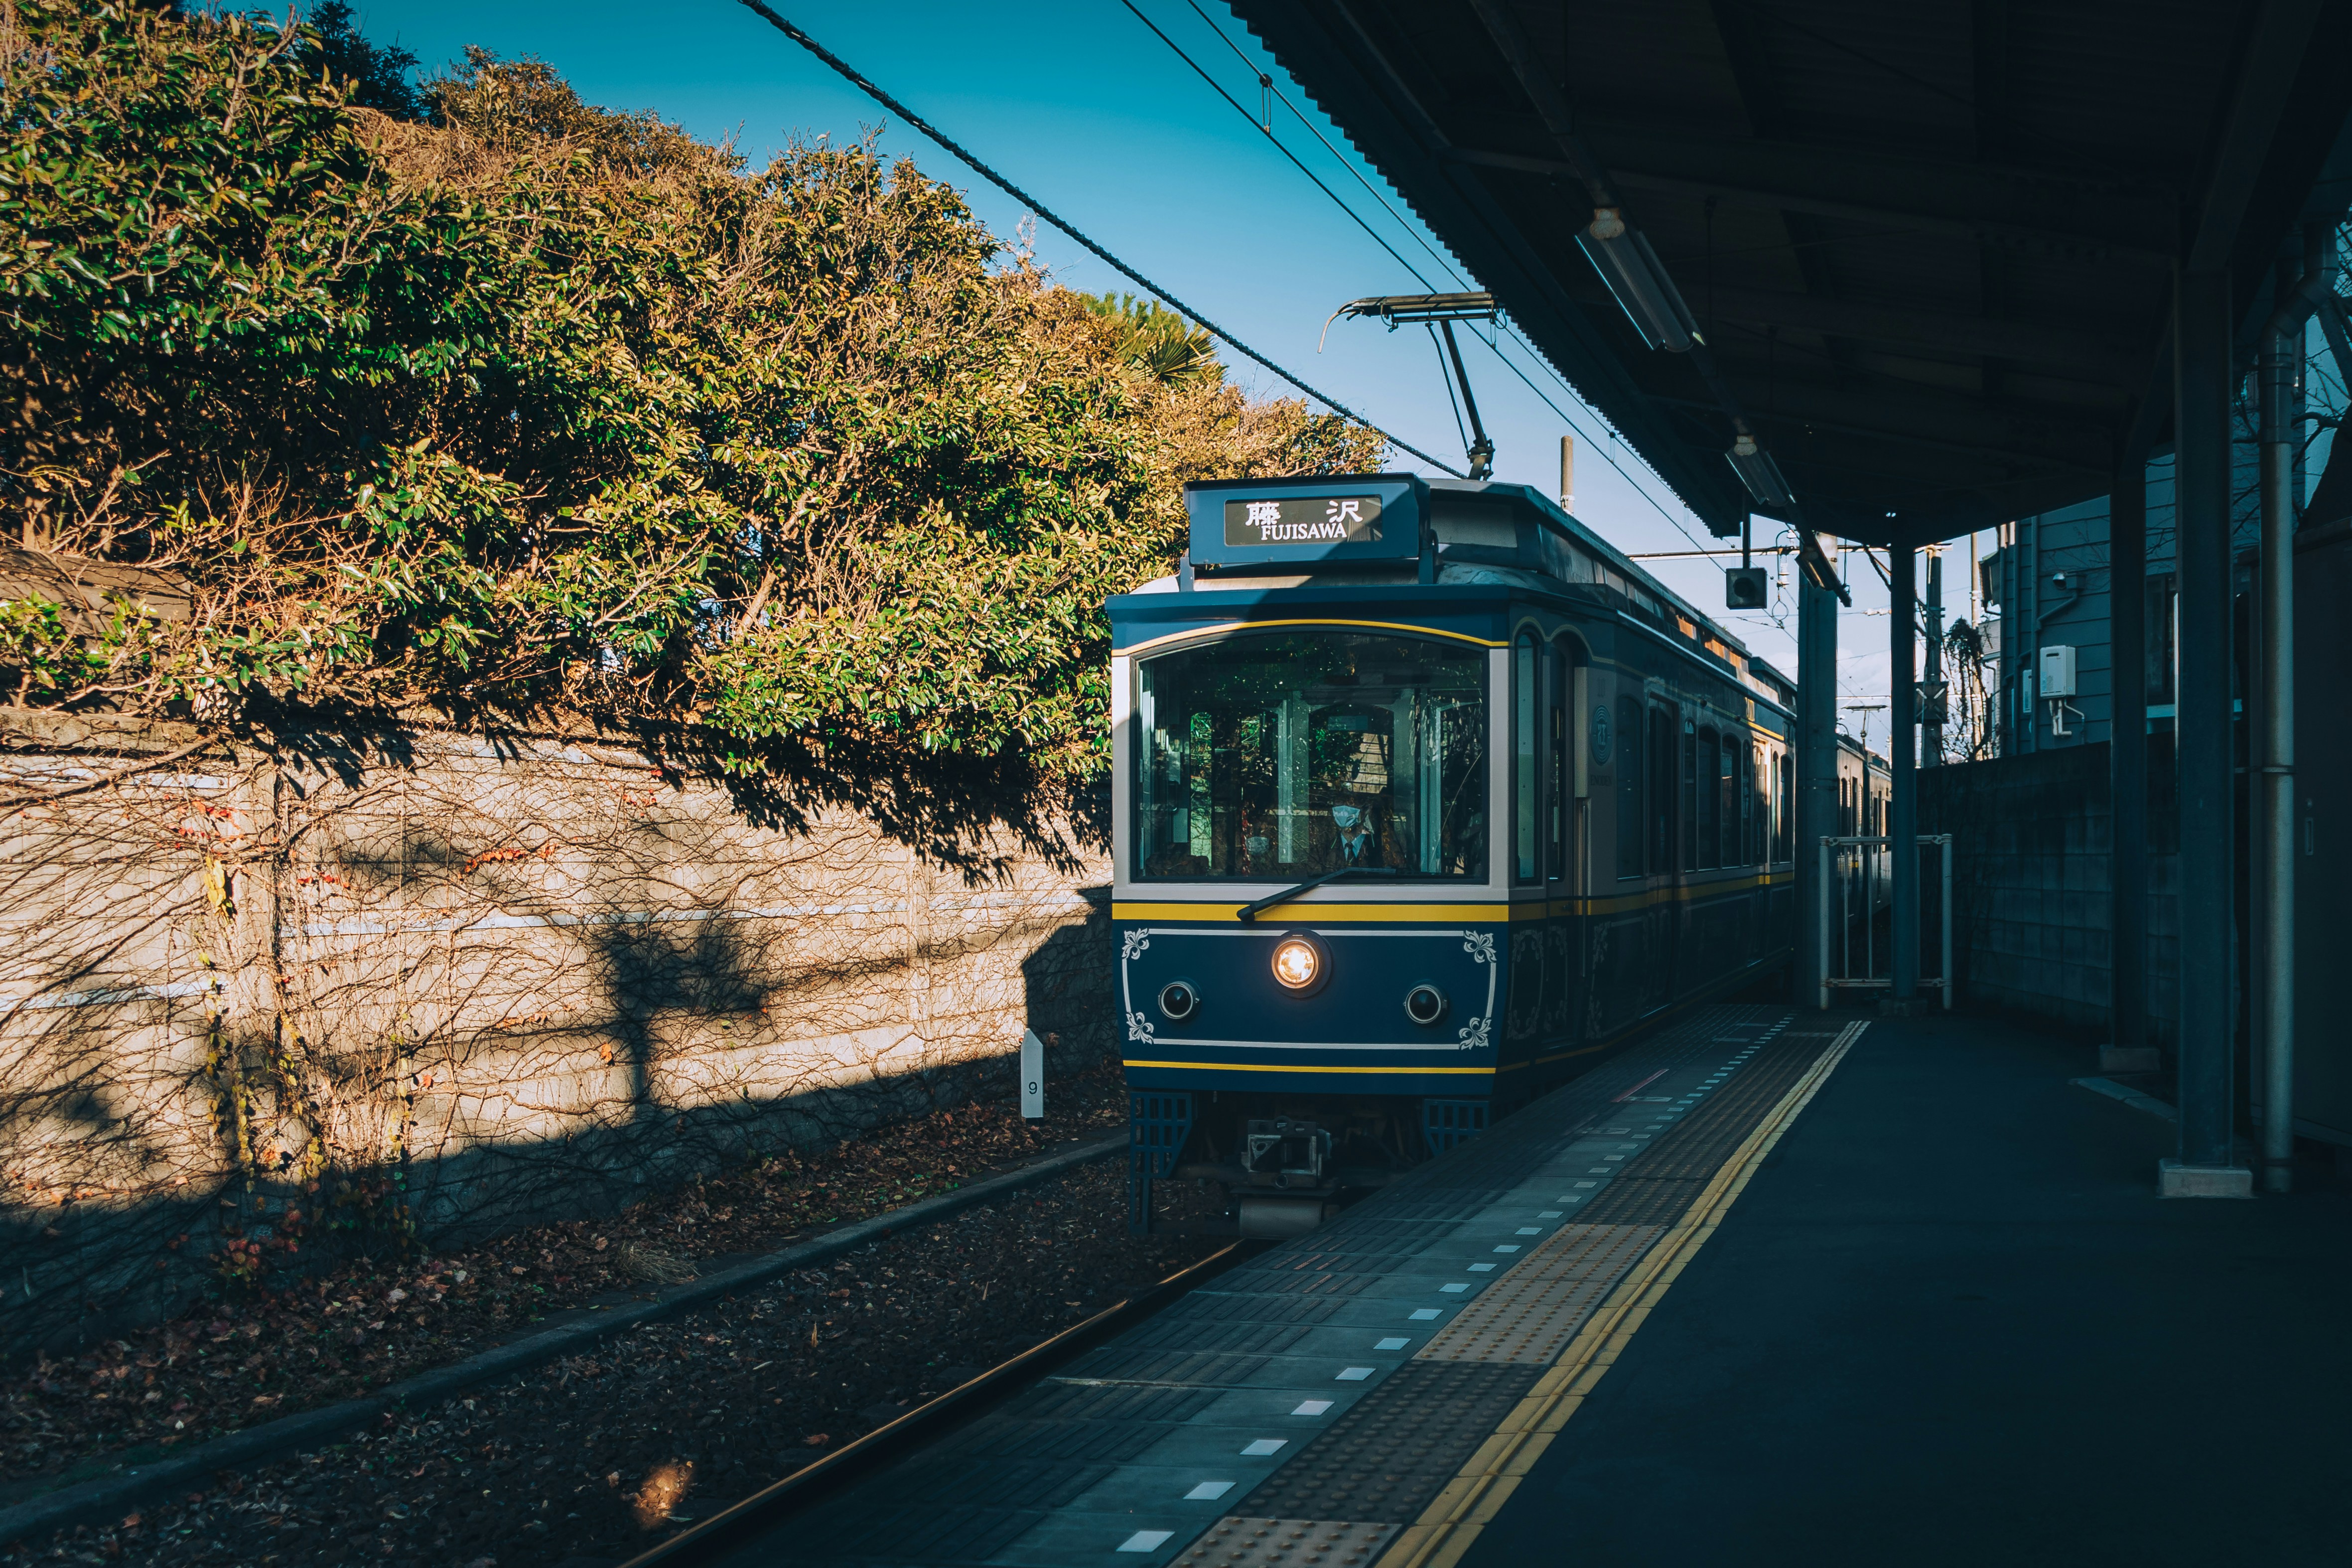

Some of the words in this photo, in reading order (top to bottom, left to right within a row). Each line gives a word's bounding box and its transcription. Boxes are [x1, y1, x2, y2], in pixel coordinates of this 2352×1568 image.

[1245, 500, 1363, 526] 藤沢
[1261, 523, 1347, 541] FUJISAWA
[1029, 1082, 1037, 1094] 9
